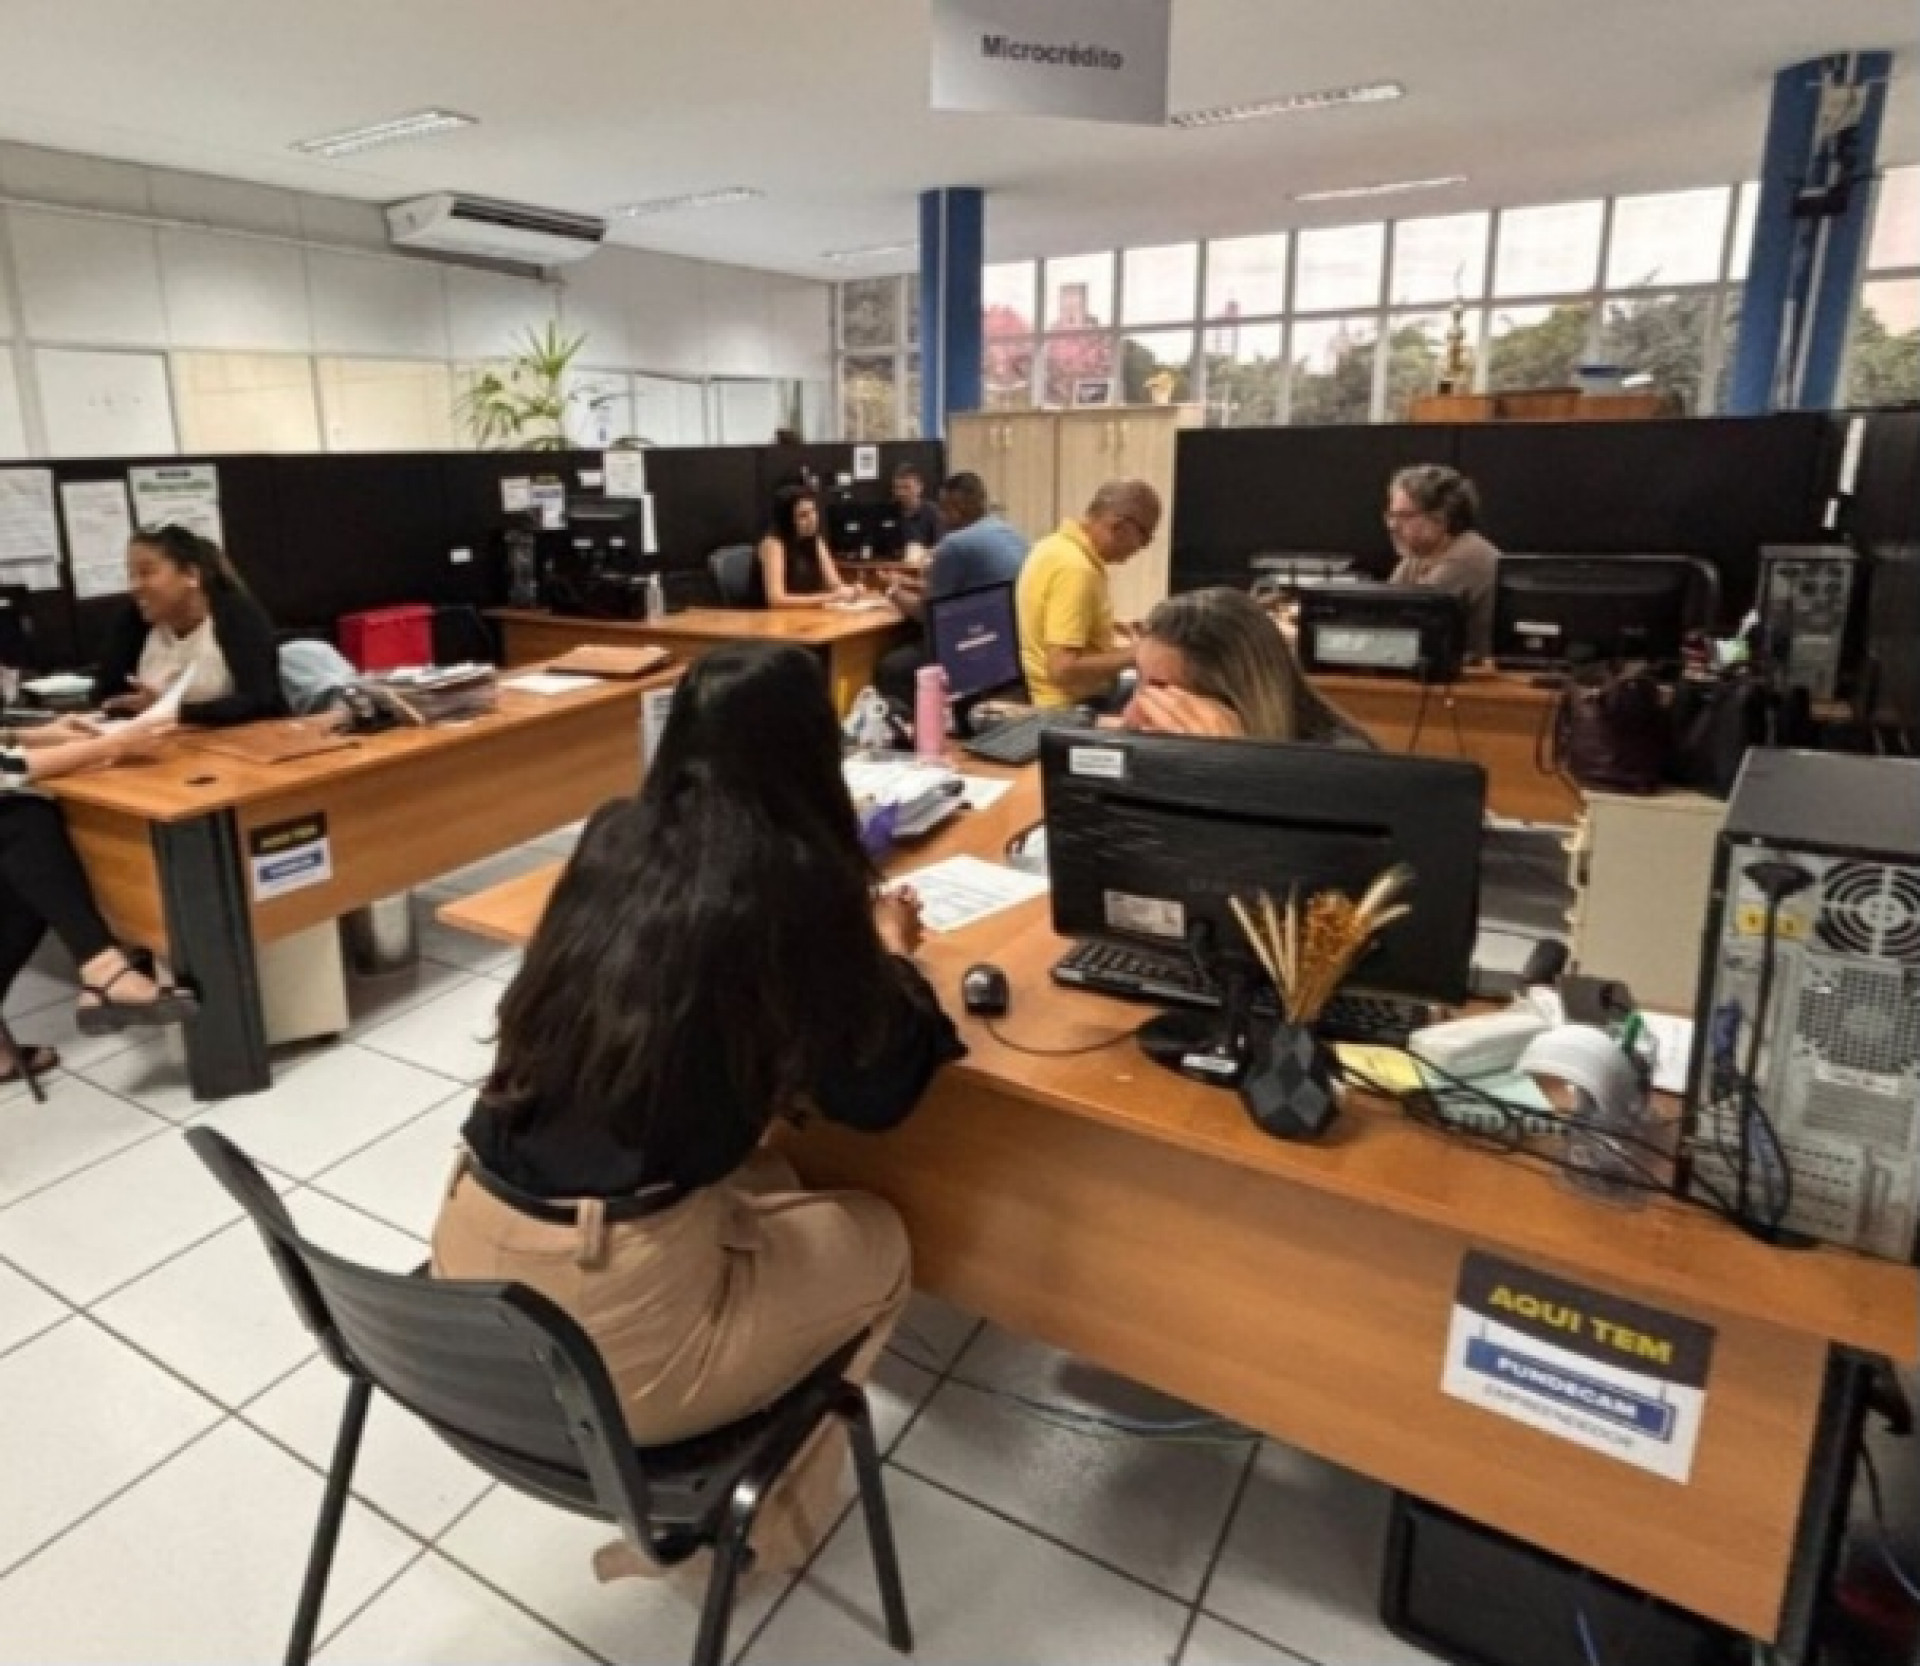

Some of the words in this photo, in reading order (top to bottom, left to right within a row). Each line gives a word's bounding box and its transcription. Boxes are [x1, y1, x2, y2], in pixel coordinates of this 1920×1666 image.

[981, 34, 1122, 70] Microcrédito
[1488, 1285, 1581, 1334] AQUI
[1591, 1318, 1673, 1366] TEM
